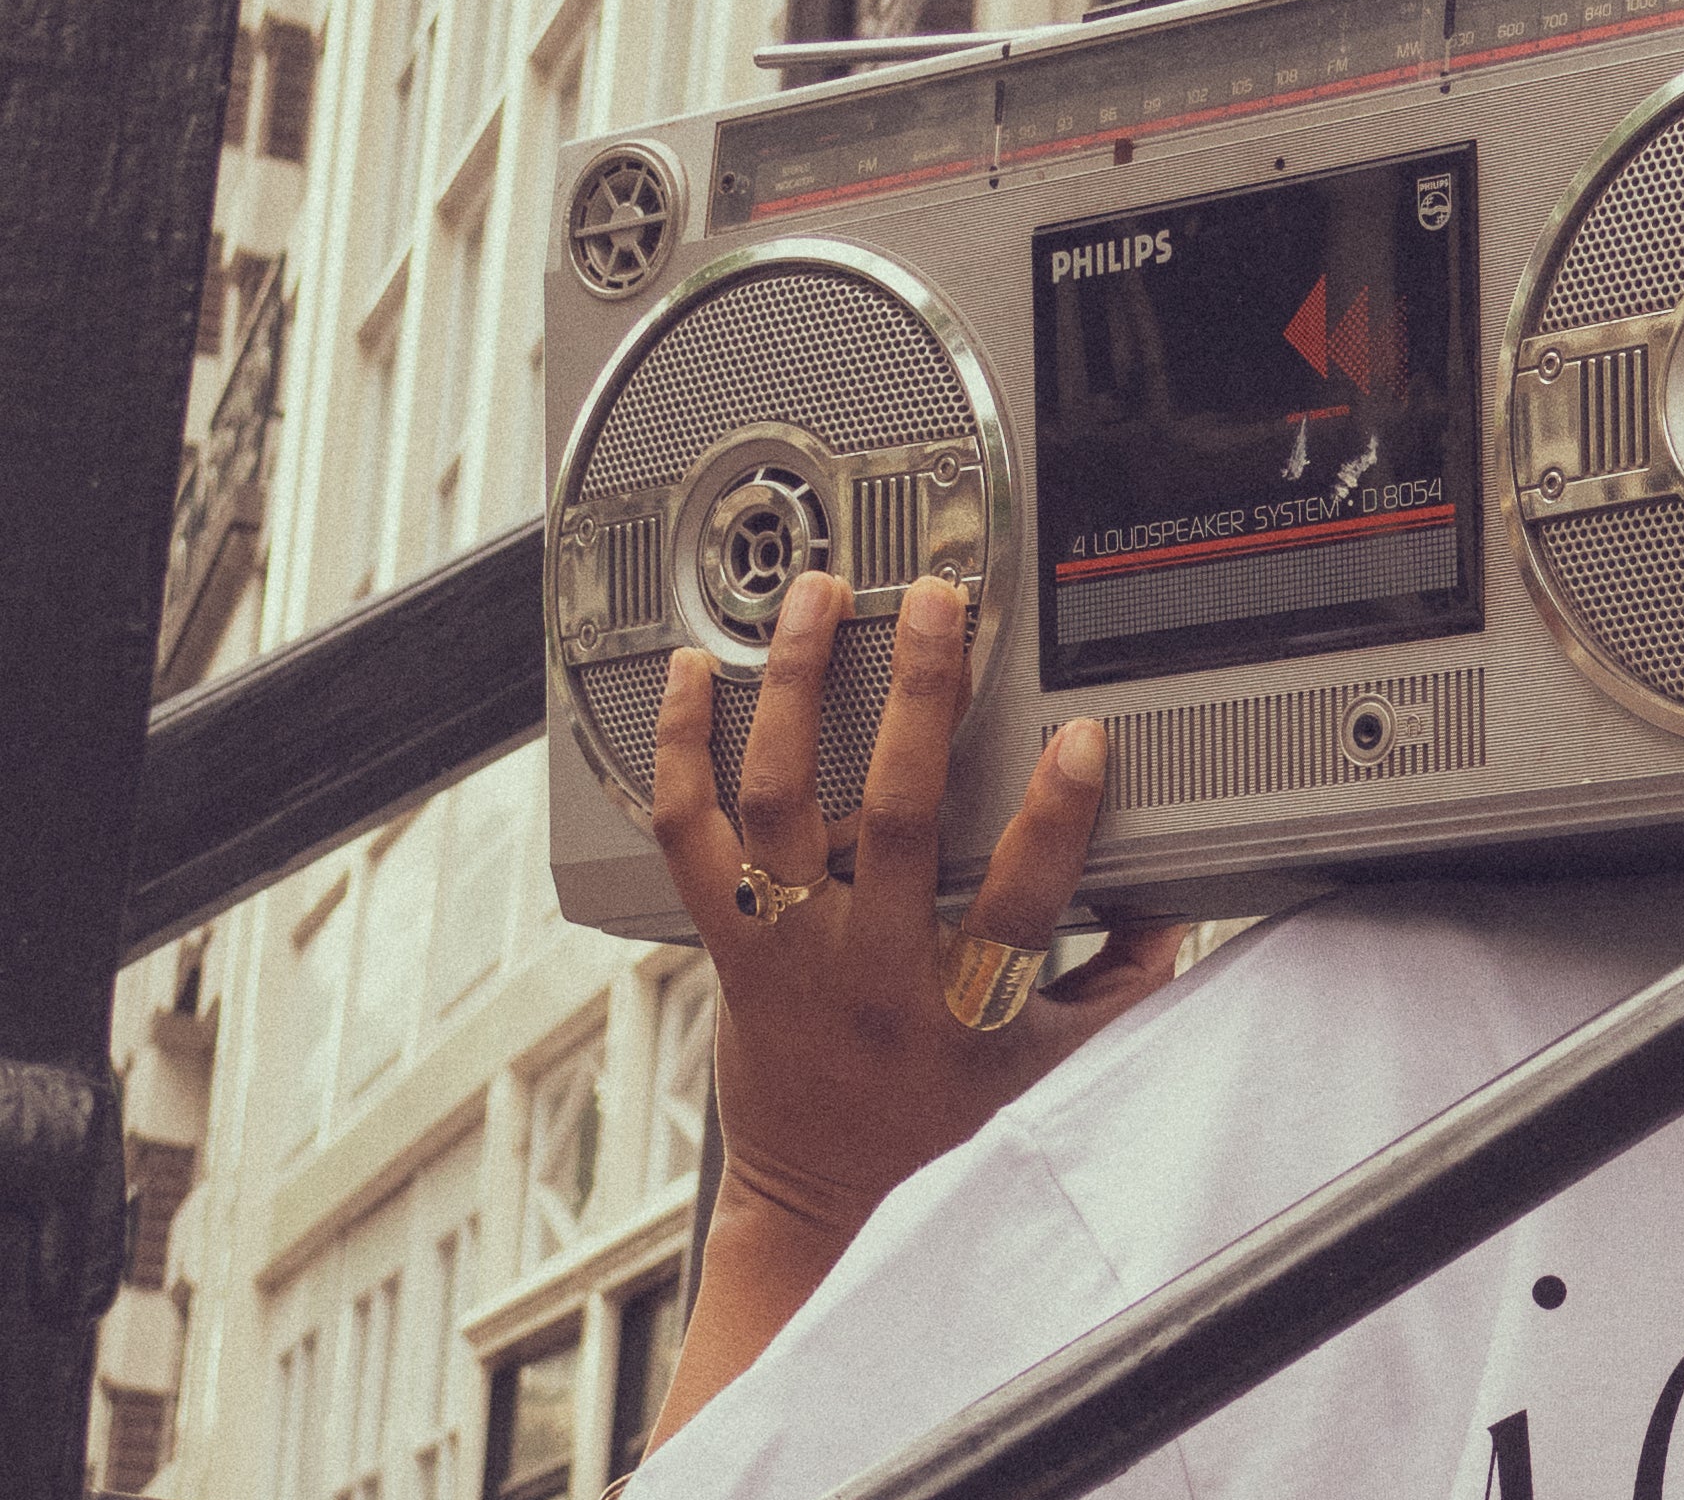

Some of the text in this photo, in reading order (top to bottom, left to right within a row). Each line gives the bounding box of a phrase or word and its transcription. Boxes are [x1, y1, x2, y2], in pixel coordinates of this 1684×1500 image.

[1397, 40, 1421, 60] MW
[1497, 21, 1525, 40] 600
[1542, 12, 1568, 30] 700
[1584, 2, 1612, 22] 840
[1056, 115, 1074, 133] 93
[1099, 107, 1118, 124] 96
[1143, 97, 1161, 115] 99
[1186, 87, 1209, 104] 102
[1231, 78, 1253, 95] 105
[1276, 69, 1298, 86] 108
[1326, 57, 1349, 75] FM
[858, 157, 878, 175] FM
[1420, 179, 1449, 192] PHILIPS
[1052, 229, 1172, 284] PHILIPS
[1072, 537, 1086, 558] 4
[1094, 510, 1245, 556] LOUDSPEAKER
[1254, 496, 1341, 531] SYSTEM
[1383, 477, 1442, 510] 8054
